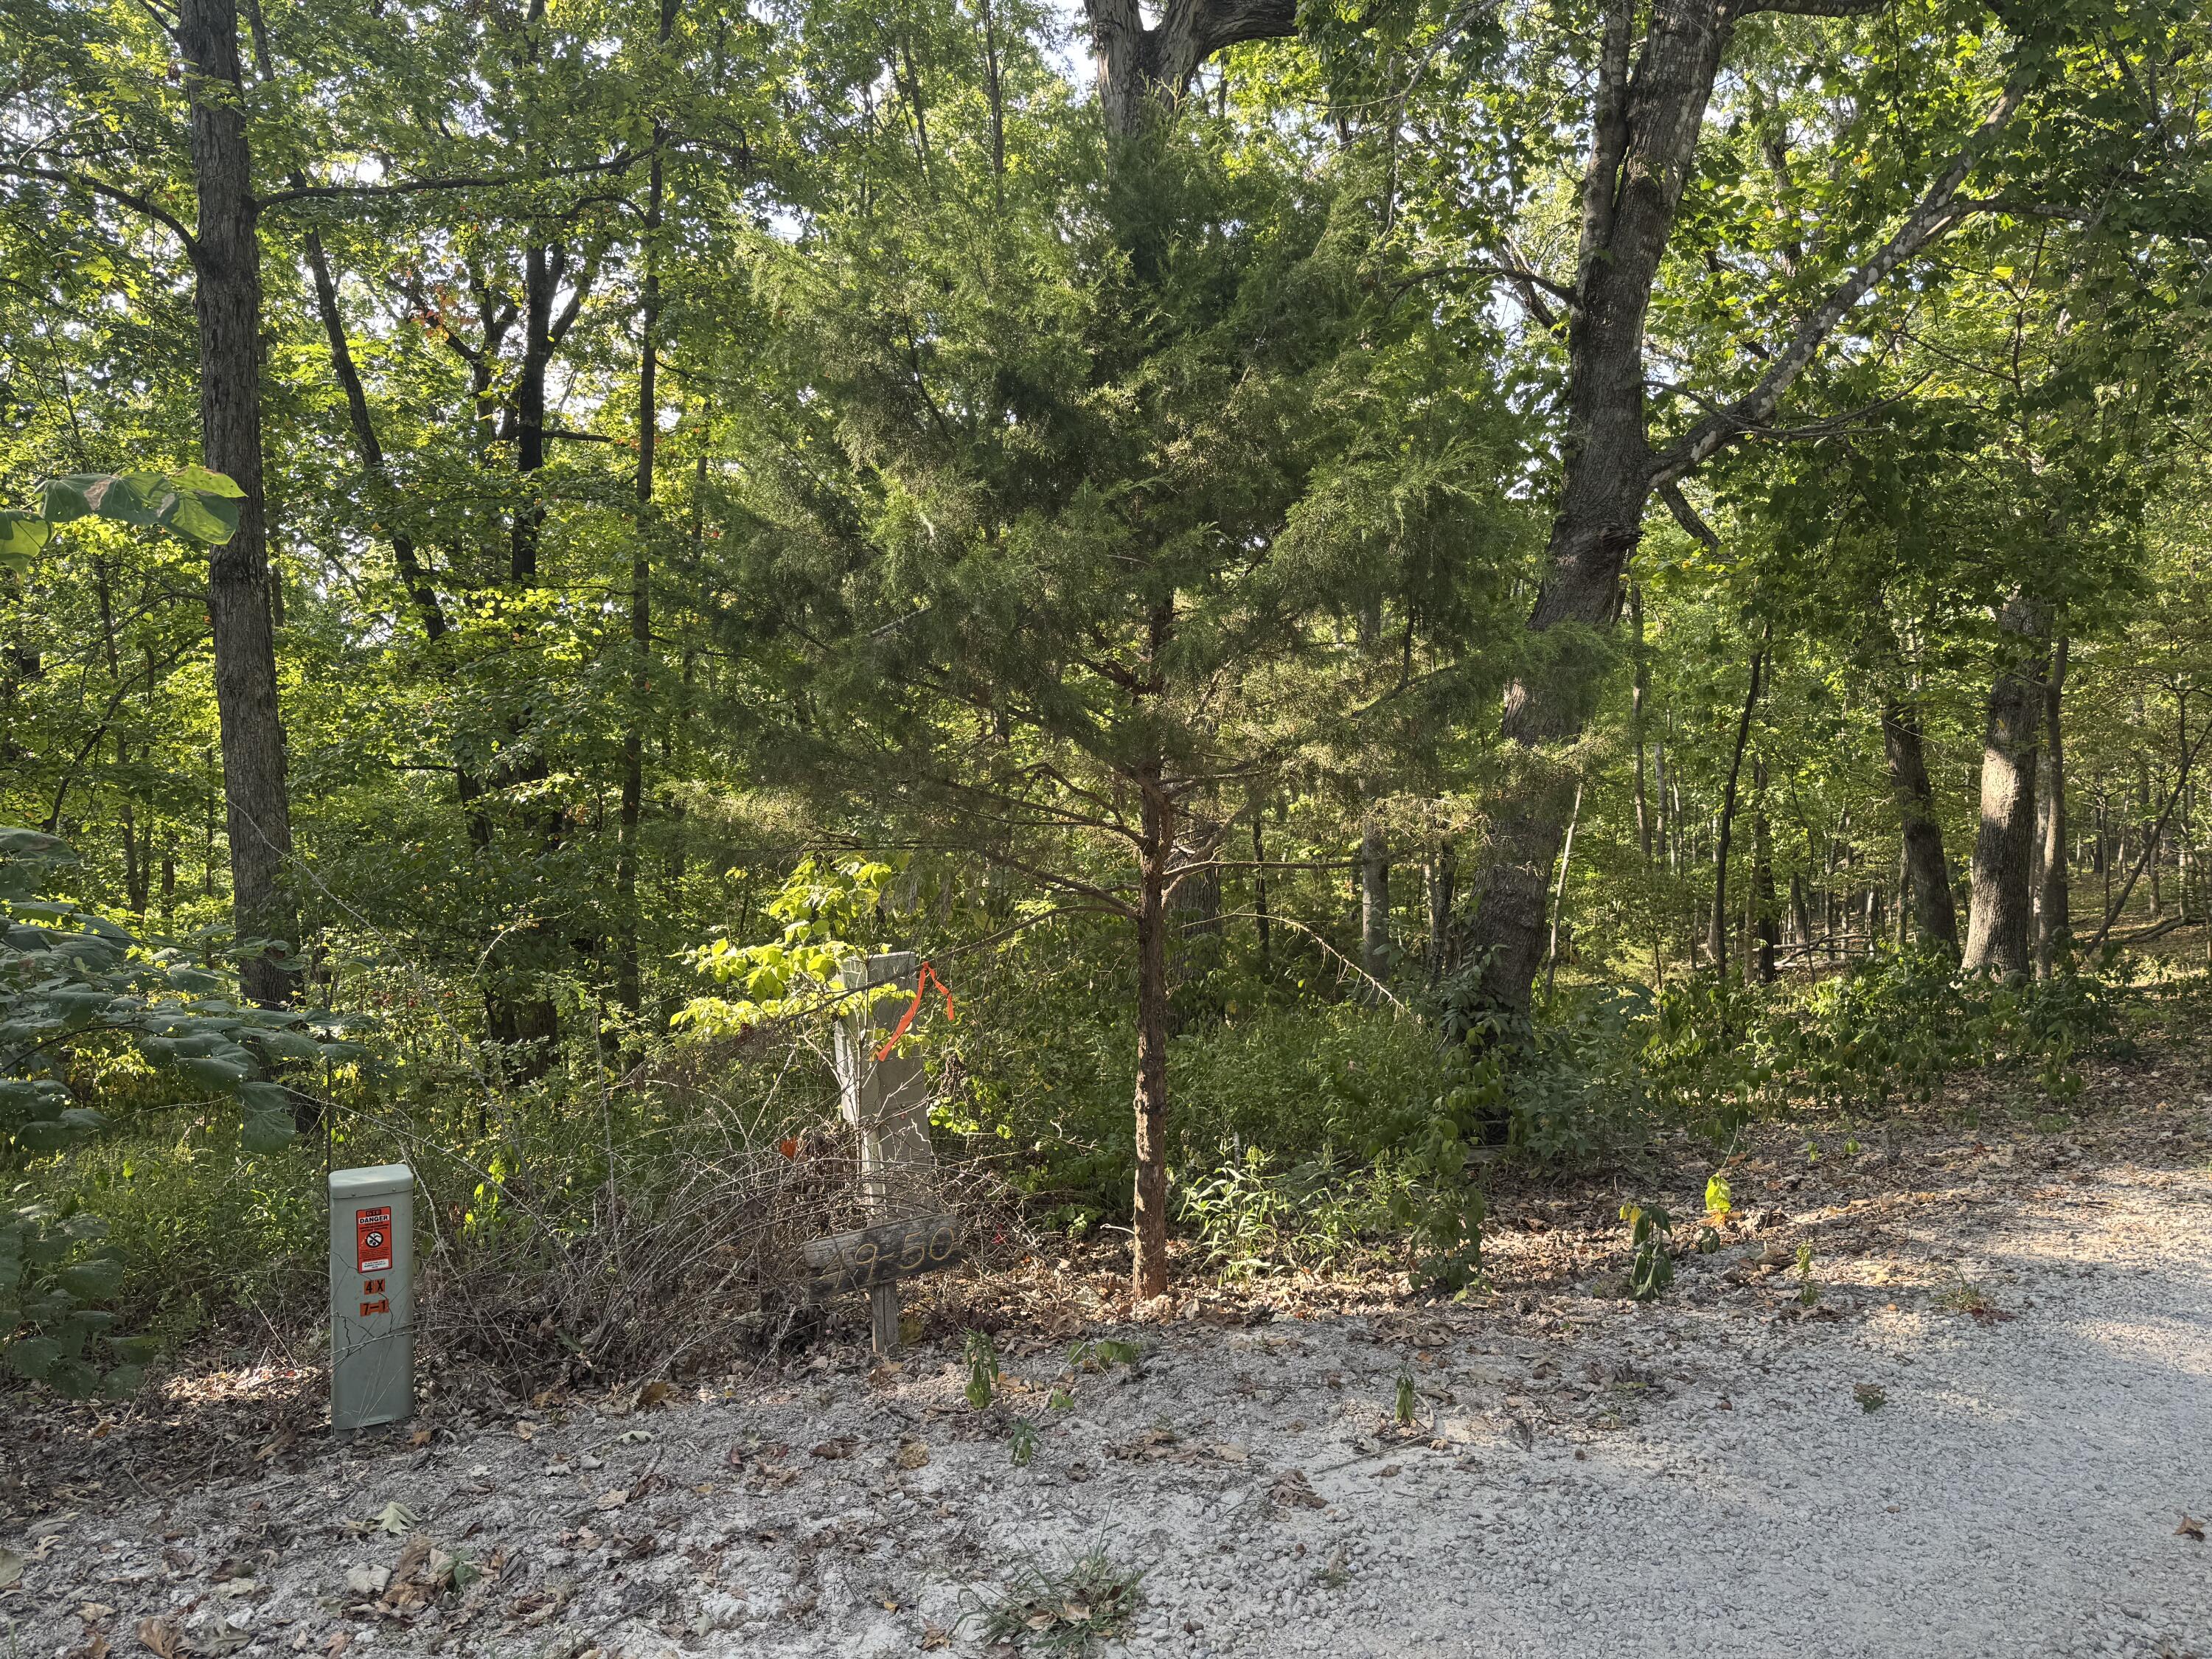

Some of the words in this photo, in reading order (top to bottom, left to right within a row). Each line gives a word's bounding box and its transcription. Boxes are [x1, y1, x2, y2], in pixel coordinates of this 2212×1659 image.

[360, 1215, 388, 1223] DANGER
[820, 1226, 955, 1290] 19-50
[363, 1300, 386, 1315] 7-1
